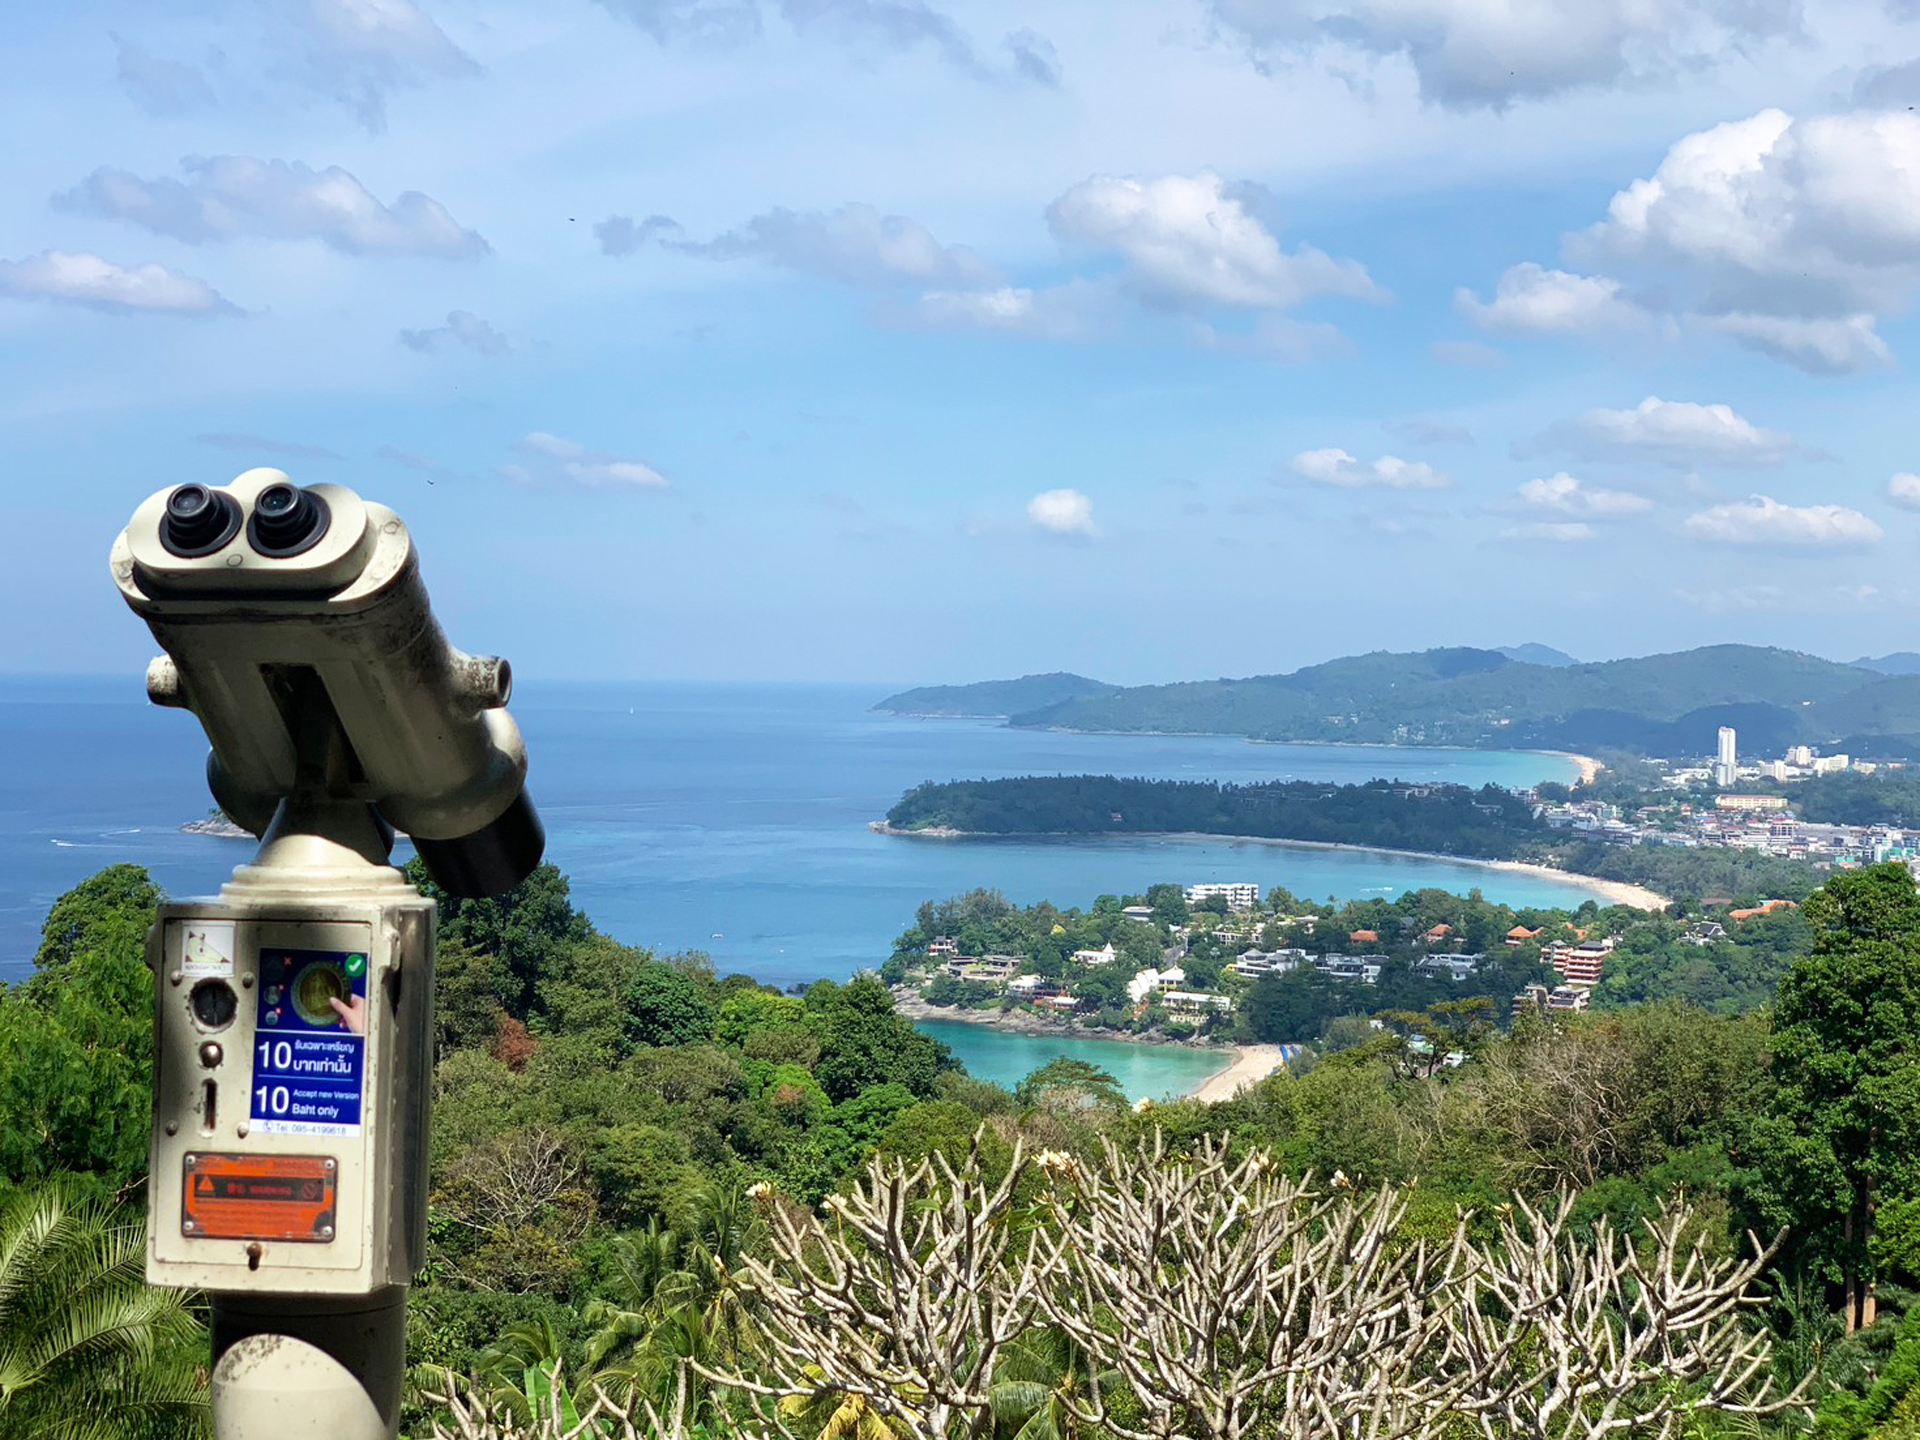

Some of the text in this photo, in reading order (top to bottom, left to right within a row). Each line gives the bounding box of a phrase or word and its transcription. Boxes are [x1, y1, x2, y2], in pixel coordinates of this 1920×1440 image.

[259, 1041, 292, 1068] 10
[293, 1054, 352, 1073] บาทเท่านั้น
[256, 1086, 289, 1113] 10
[293, 1089, 359, 1100] Accept new Version
[292, 1103, 339, 1118] Baht only
